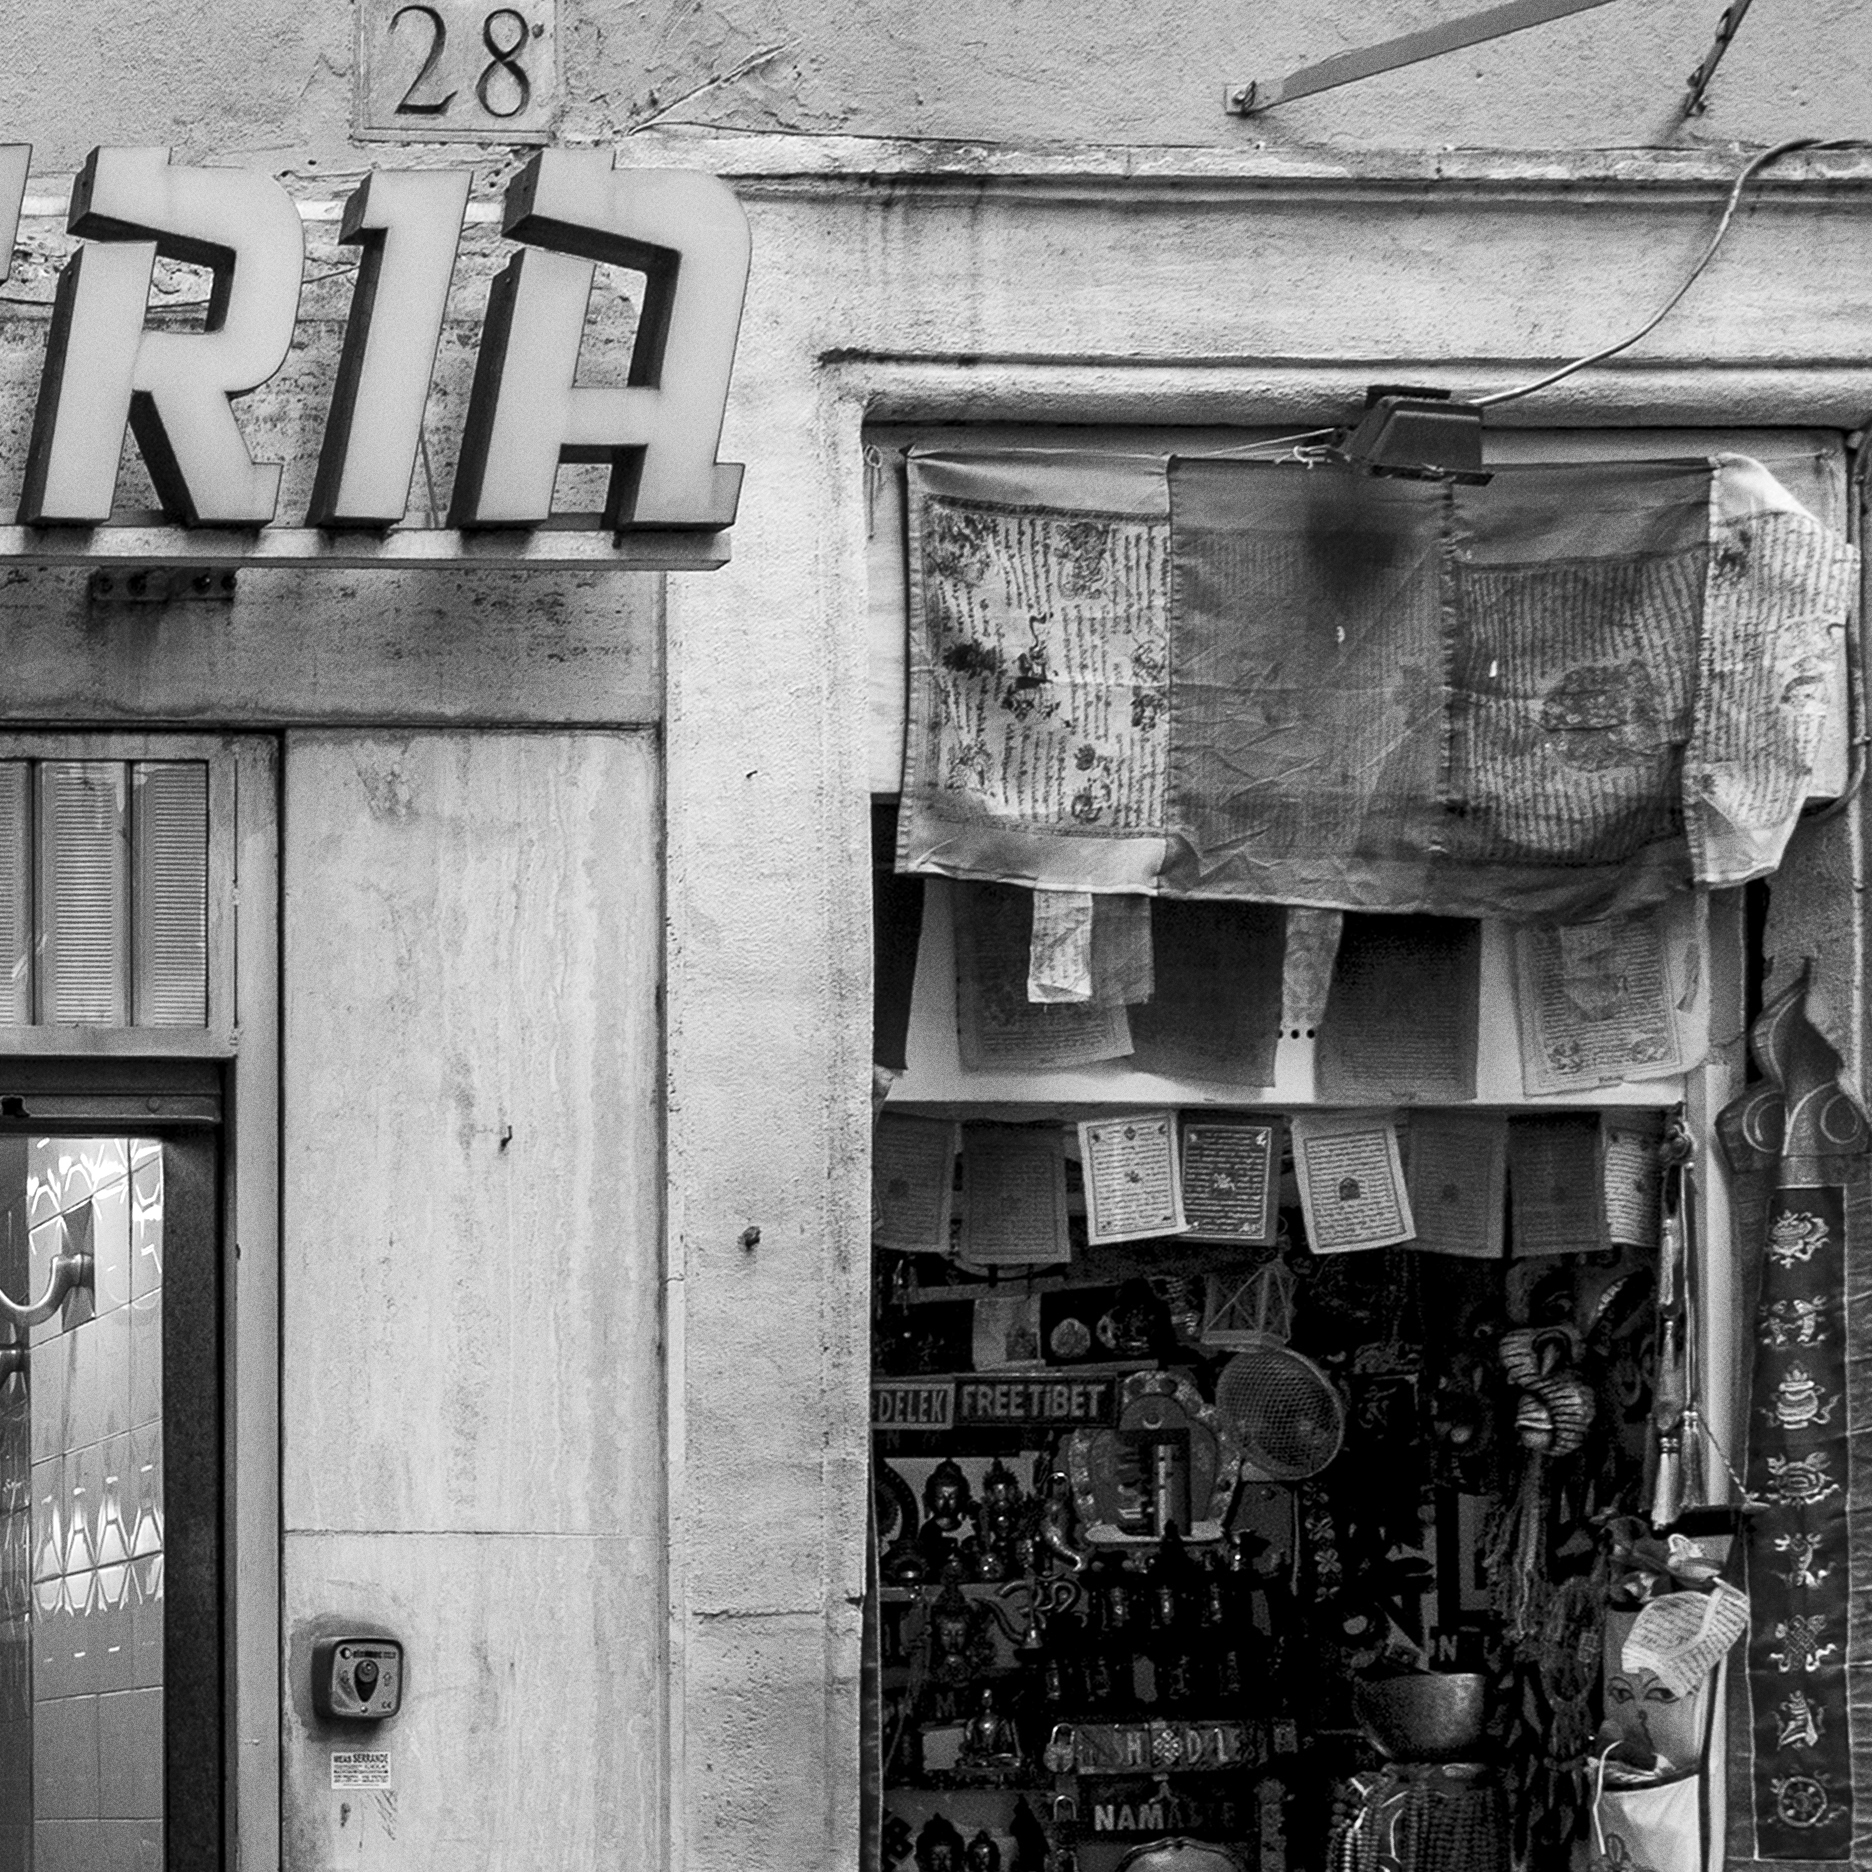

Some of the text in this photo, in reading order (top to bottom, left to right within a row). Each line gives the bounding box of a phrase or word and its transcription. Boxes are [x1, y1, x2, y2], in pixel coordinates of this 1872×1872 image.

[388, 5, 530, 117] 28
[878, 1390, 946, 1424] DELEK
[960, 1384, 1025, 1417] FREE
